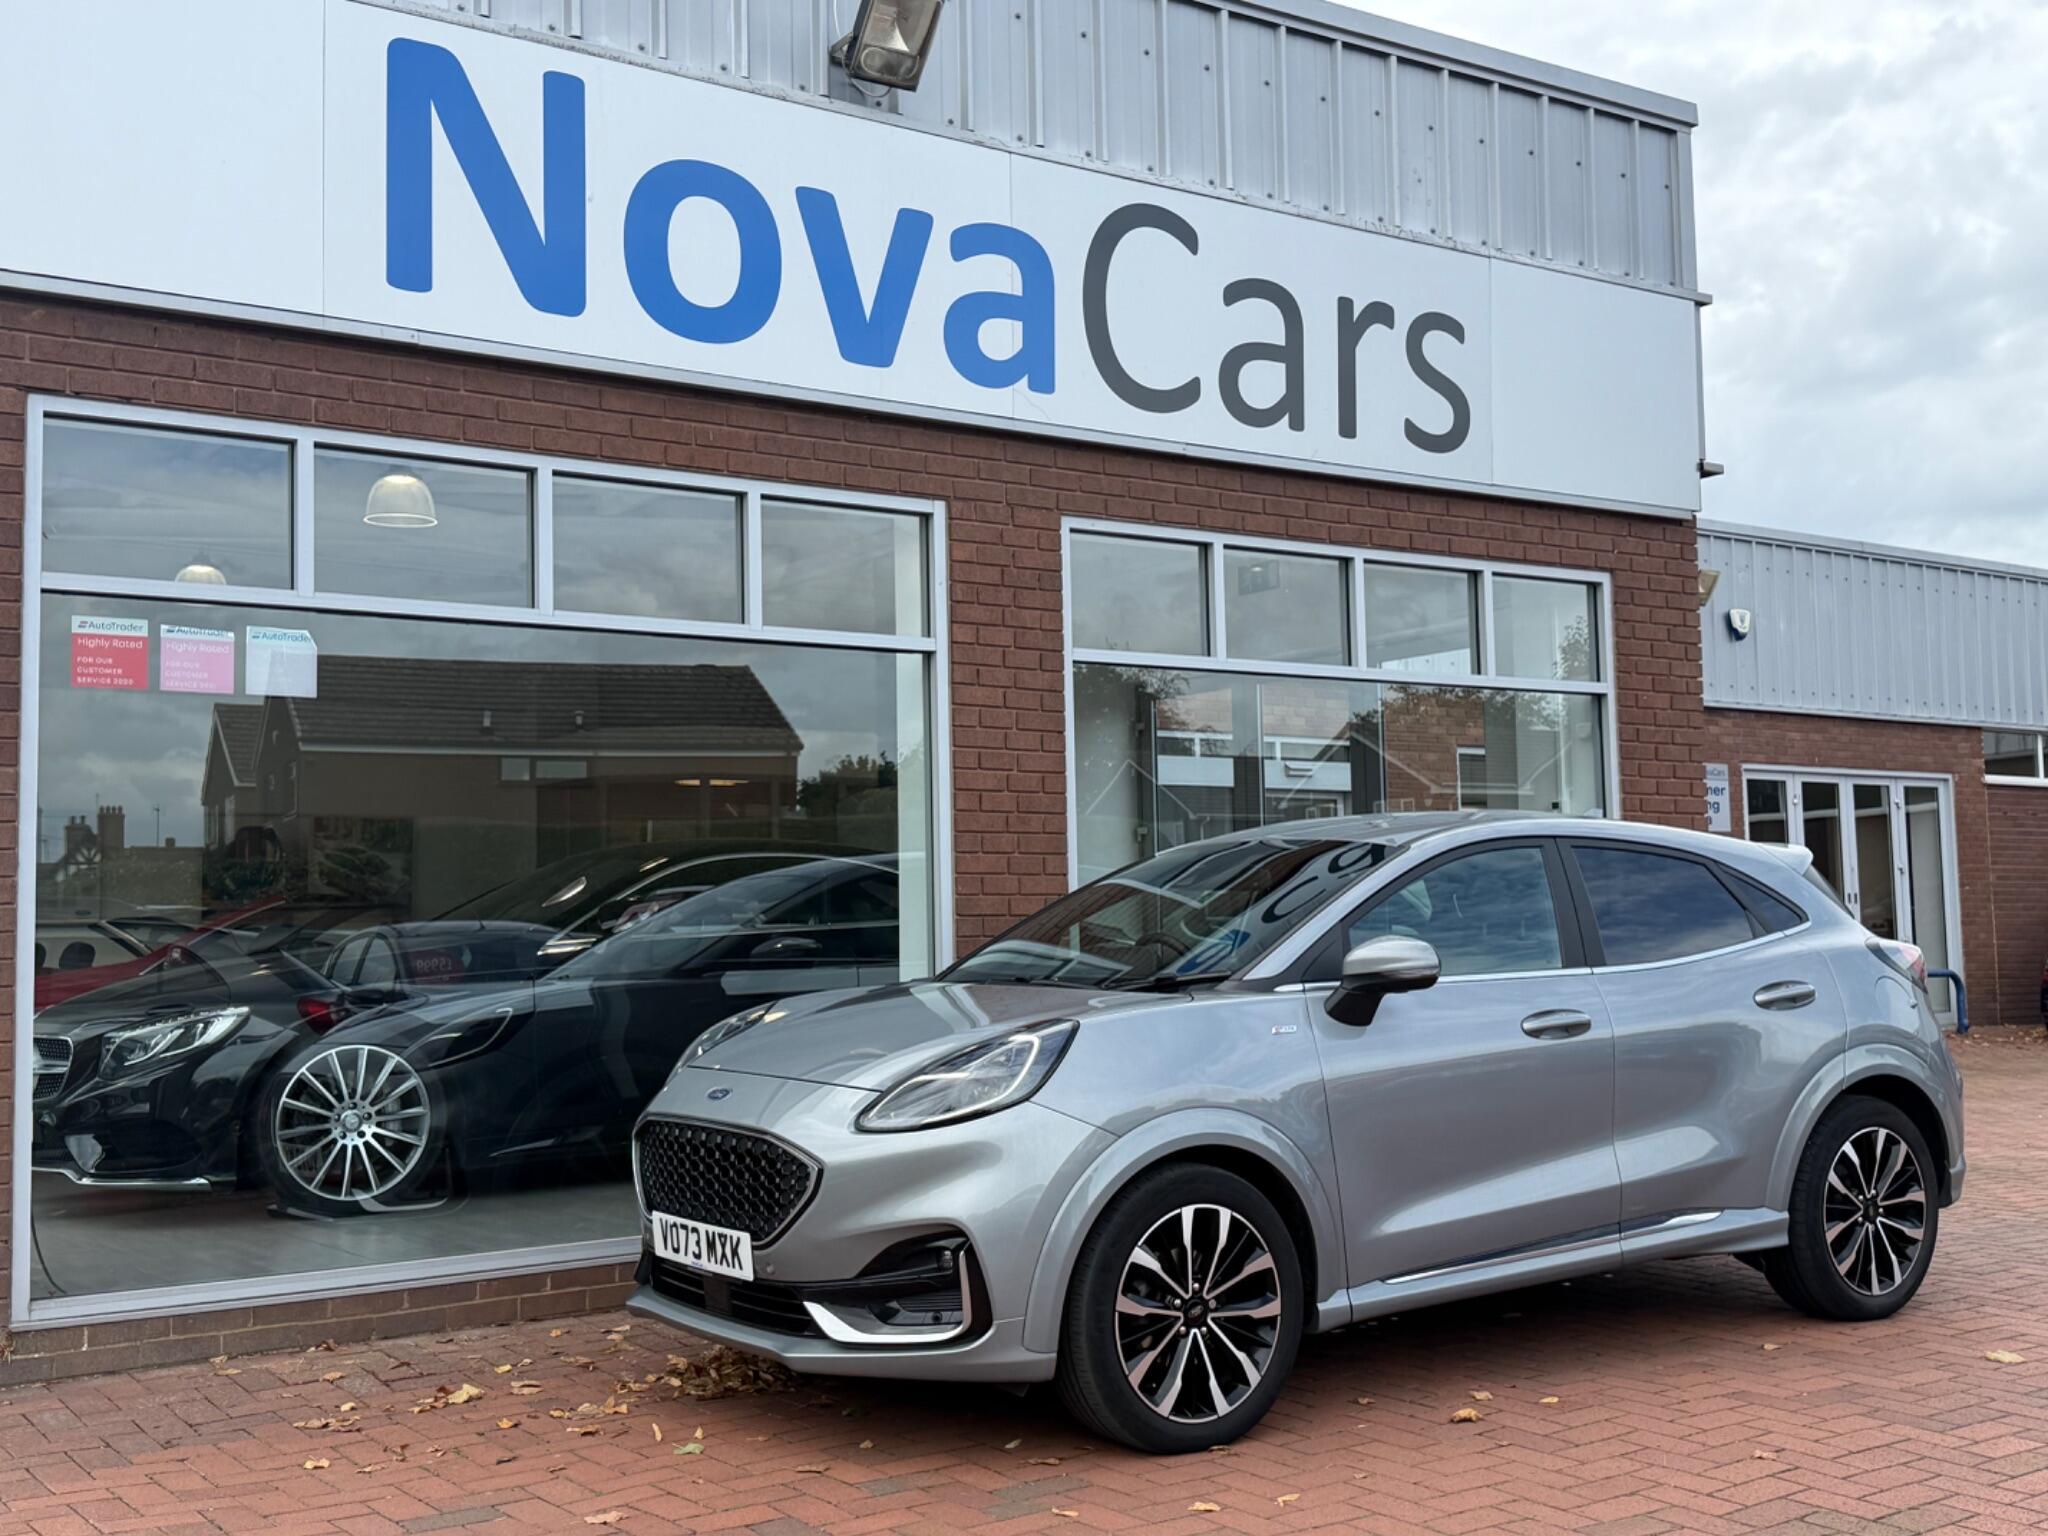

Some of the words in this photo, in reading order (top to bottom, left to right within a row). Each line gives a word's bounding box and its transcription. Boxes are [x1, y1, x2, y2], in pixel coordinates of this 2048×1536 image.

[386, 37, 1471, 453] NovaCars
[88, 621, 144, 632] AutoTrader
[78, 636, 110, 649] Highly
[112, 638, 143, 649] Rated
[77, 665, 123, 675] CUSTOMER
[705, 1229, 743, 1271] MXK
